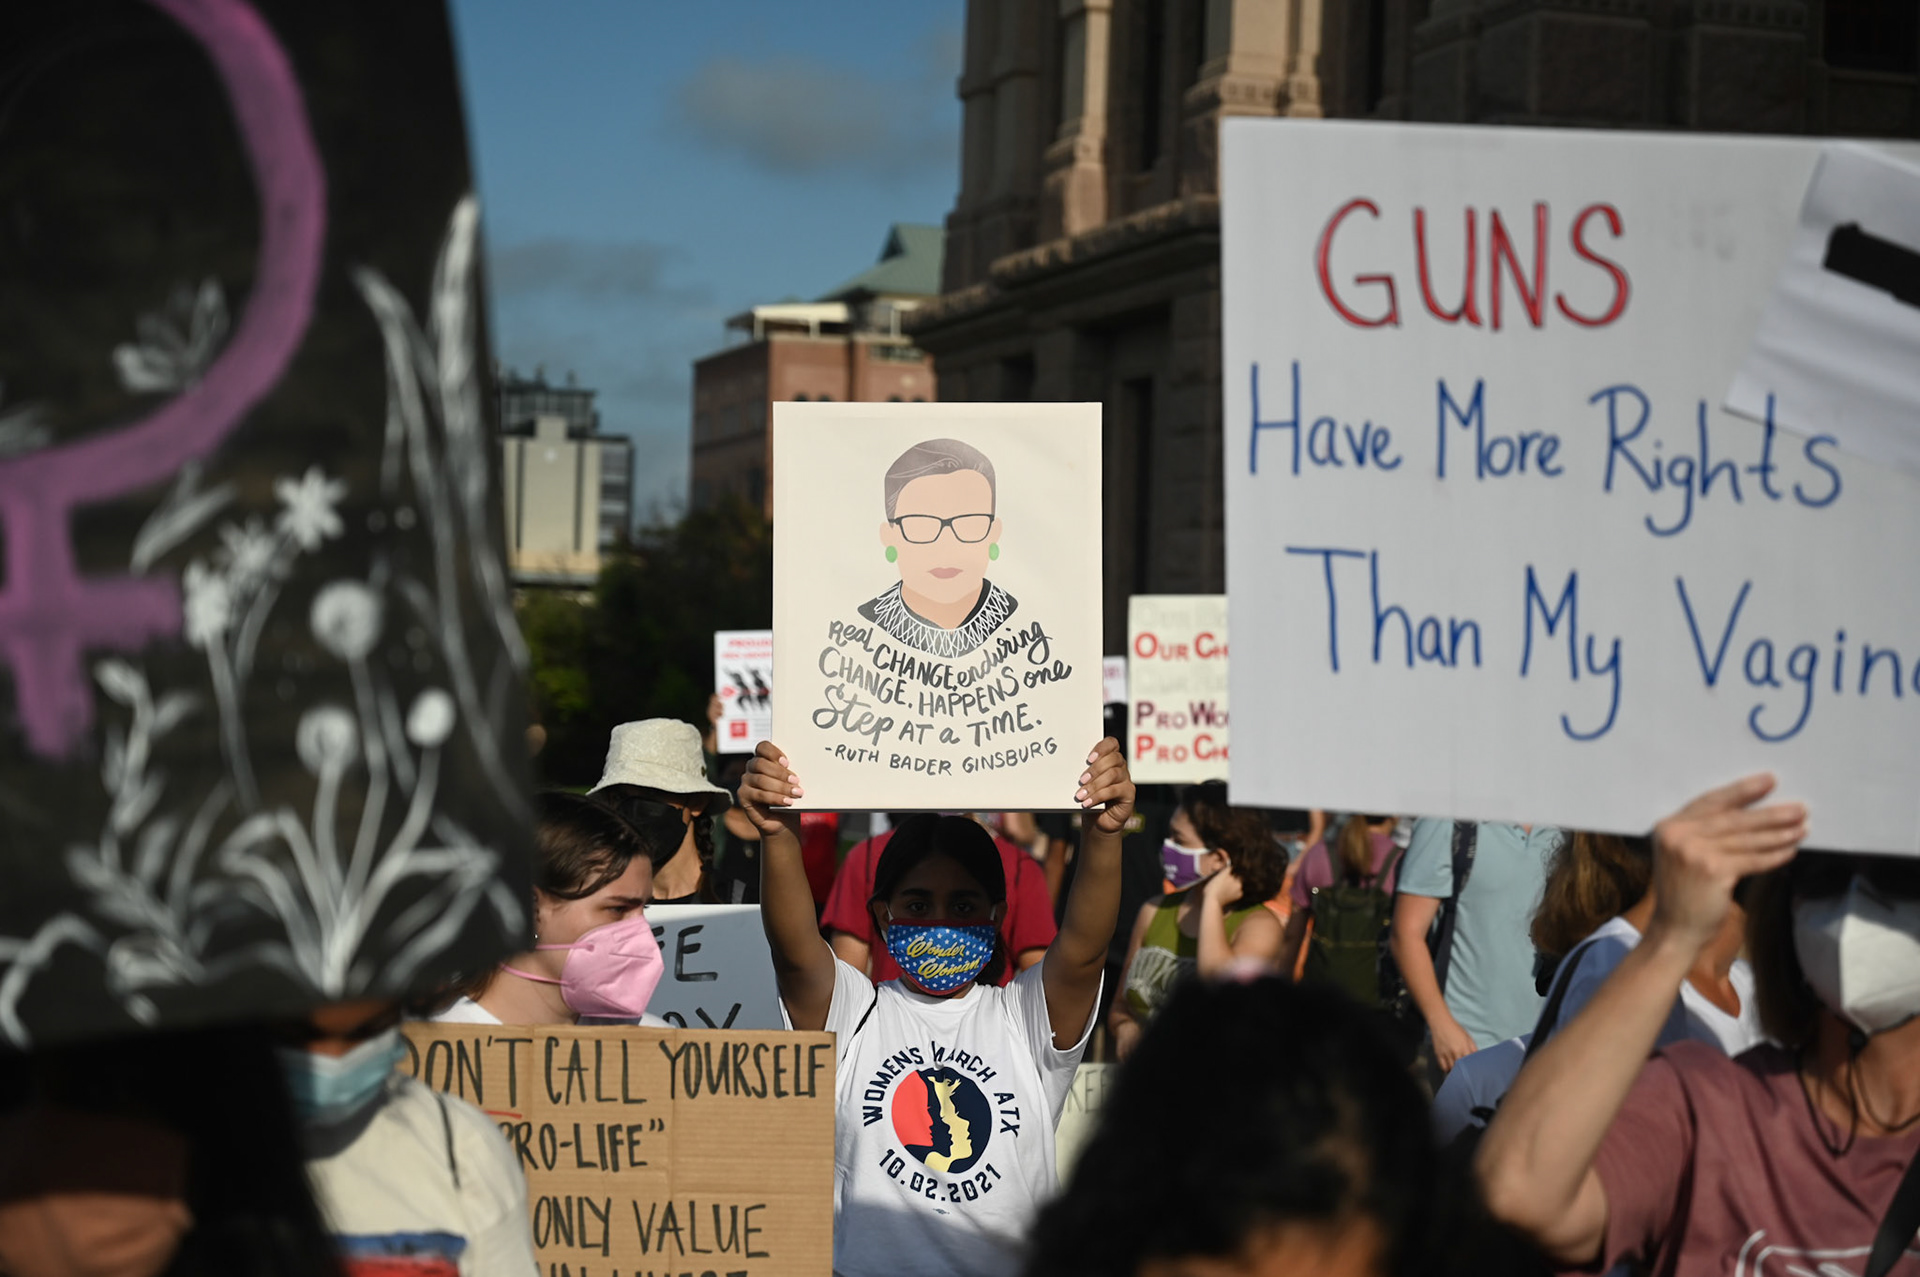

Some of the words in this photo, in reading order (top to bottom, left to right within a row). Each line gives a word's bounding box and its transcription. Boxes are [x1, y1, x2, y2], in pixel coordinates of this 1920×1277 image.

[1316, 197, 1632, 332] GUNS
[1250, 361, 1402, 476] Have
[1436, 378, 1565, 480] More
[1588, 384, 1843, 537] Rights
[829, 620, 875, 653] Real
[957, 621, 1054, 688] enduring
[1194, 631, 1229, 660] CH
[1286, 547, 1483, 674] Than
[1519, 564, 1623, 742] My
[812, 683, 895, 747] Step
[899, 719, 935, 746] AT
[939, 727, 961, 745] a
[919, 666, 1019, 717] HAPPENS
[1023, 659, 1073, 688] one
[1190, 701, 1228, 729] WO
[889, 753, 952, 776] BADER
[962, 737, 1058, 774] GINSBURG
[1193, 733, 1228, 761] CH
[906, 935, 966, 958] Wonder
[917, 957, 981, 980] Woman
[544, 1036, 648, 1105] CALL
[658, 1039, 832, 1100] YOURSELF
[931, 1040, 998, 1084] MARCH
[993, 1091, 1021, 1139] ATX
[878, 1148, 1002, 1203] 10.02.2021
[532, 1195, 612, 1257] ONLY
[632, 1200, 770, 1258] VALUE
